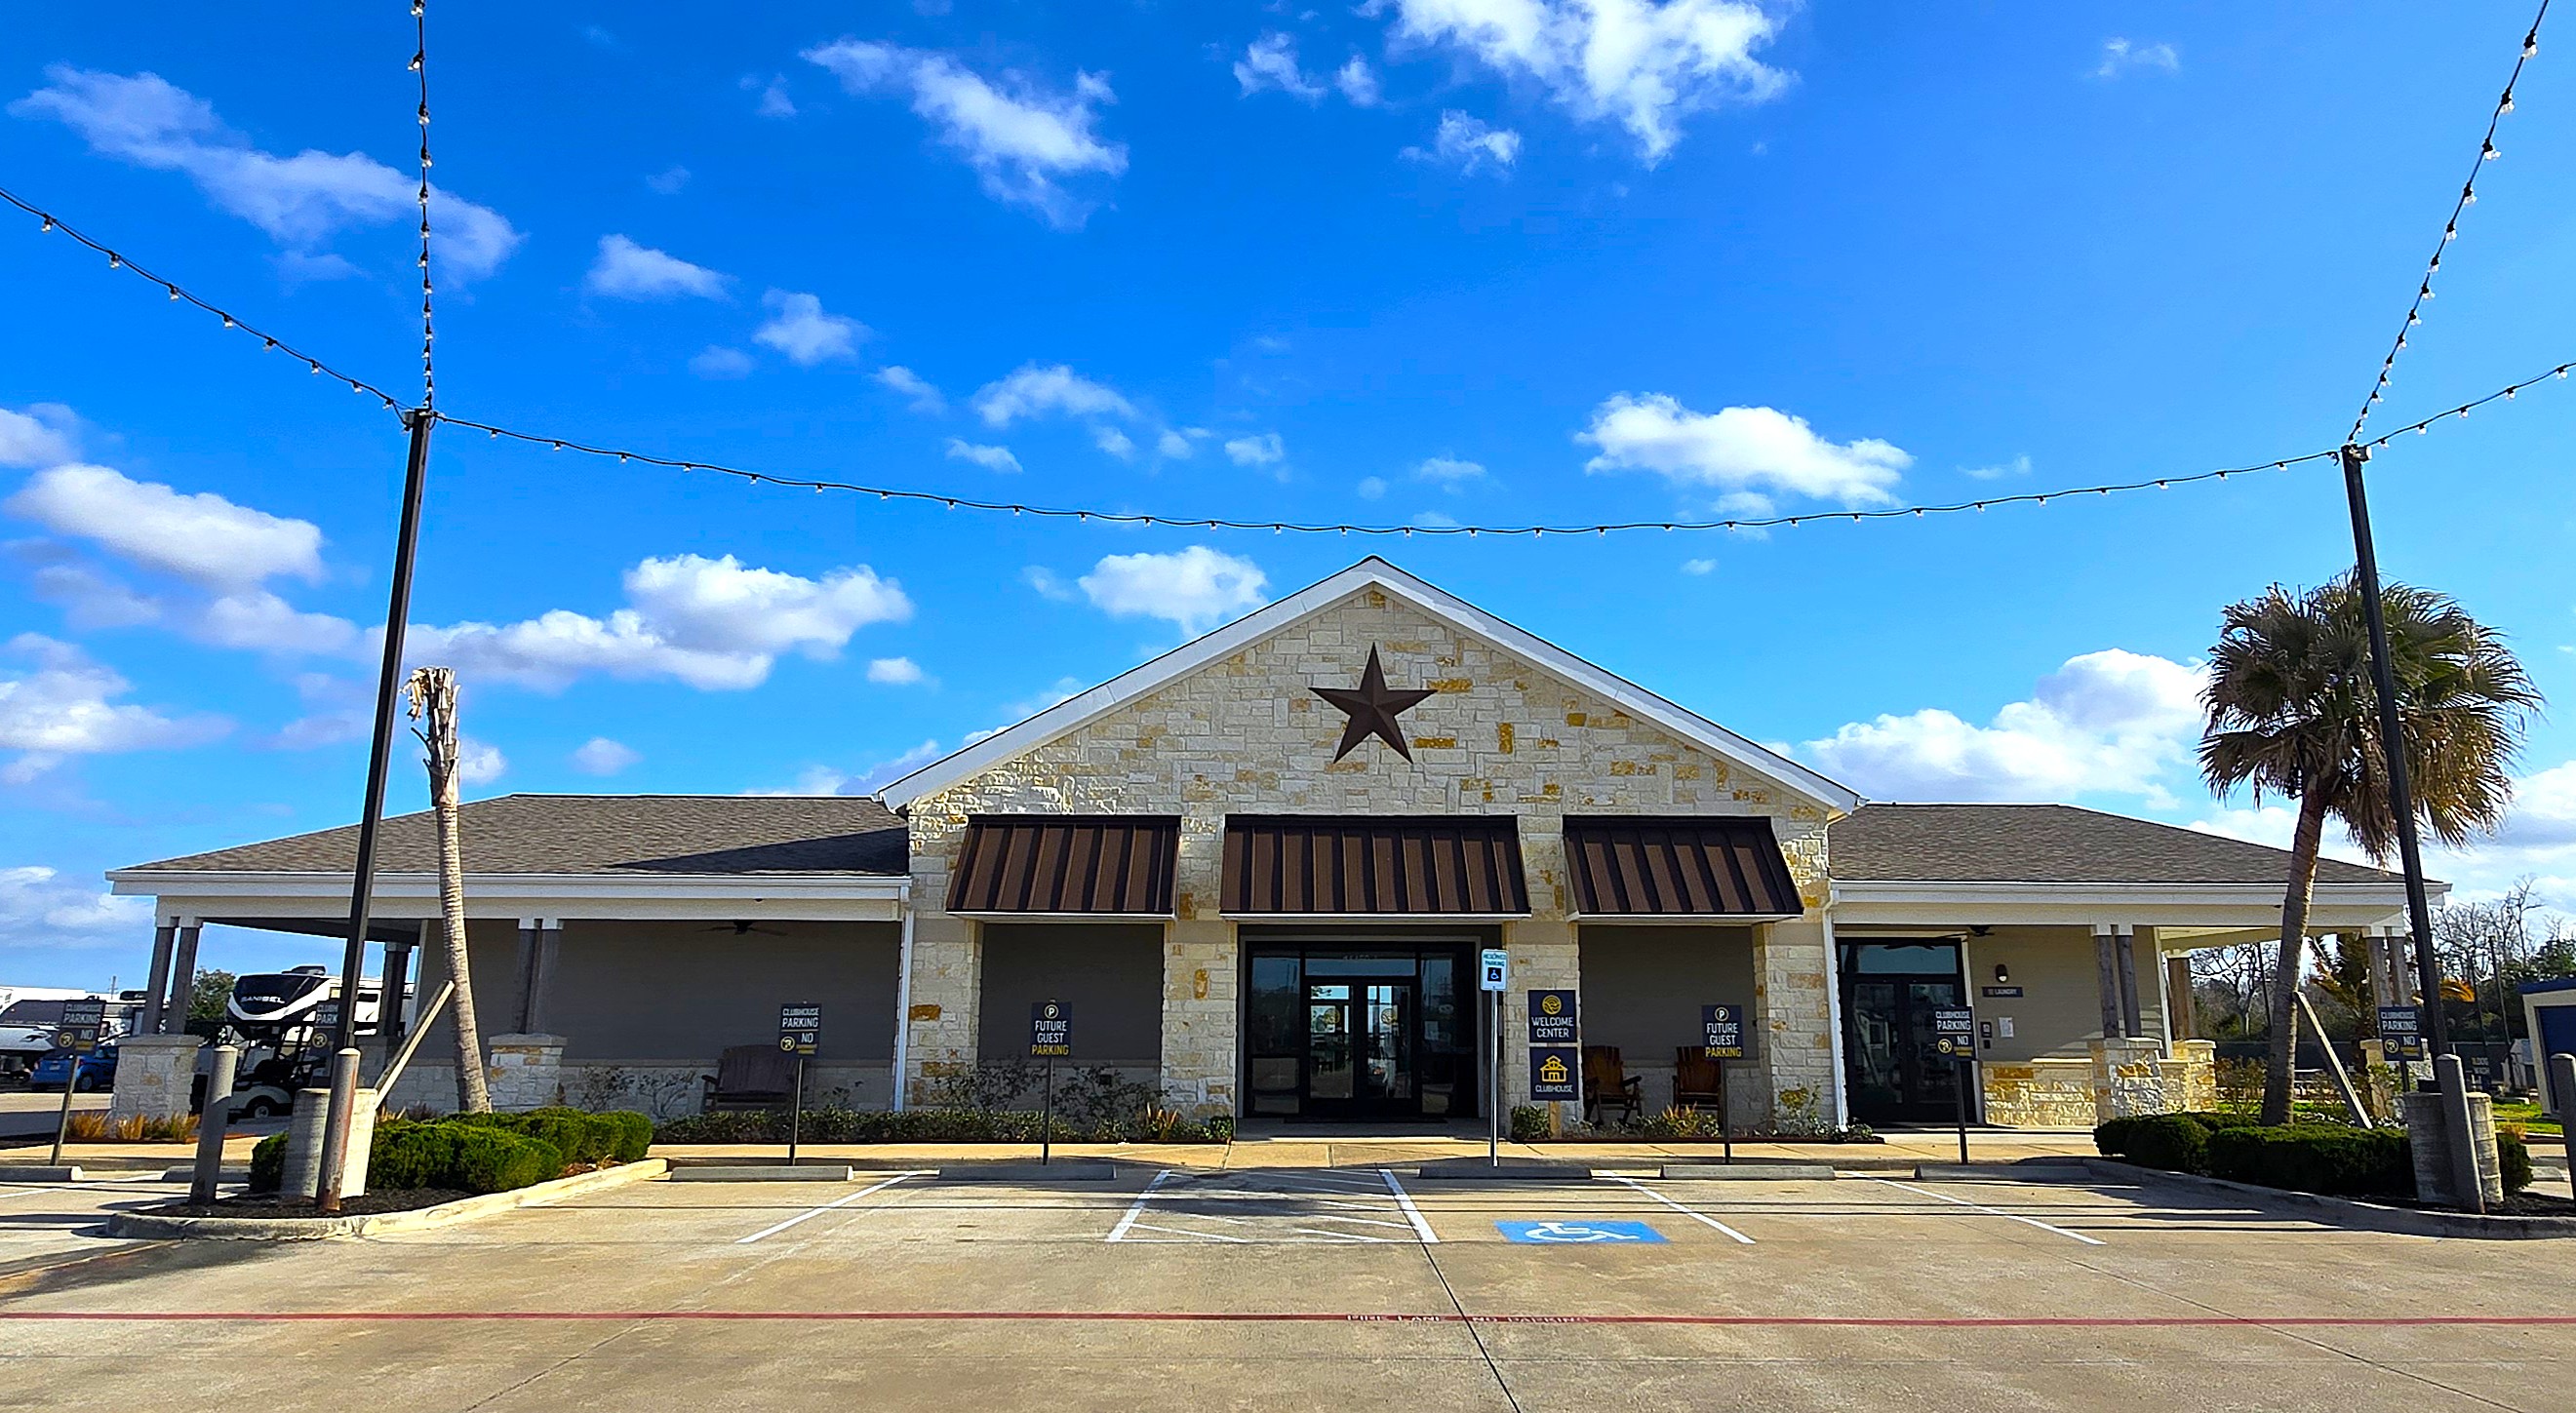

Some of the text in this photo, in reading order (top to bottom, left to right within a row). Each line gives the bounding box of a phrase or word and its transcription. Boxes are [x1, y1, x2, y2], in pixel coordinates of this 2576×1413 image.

[317, 1004, 339, 1013] CLUBH
[782, 1007, 819, 1016] CLUBHOUSE
[63, 1013, 100, 1024] PARKING
[316, 1014, 338, 1024] PARK
[1935, 1010, 1970, 1019] CLUBHOUSE
[2380, 1011, 2416, 1020] CLUBHOUSE
[781, 1017, 819, 1028] PARKING
[1035, 1020, 1068, 1032] FUTURE
[1531, 1017, 1574, 1027] WELCOME
[1936, 1020, 1971, 1031] PARKING
[2382, 1020, 2418, 1031] PARKING
[1706, 1022, 1739, 1034] FUTURE
[80, 1029, 95, 1040] NO
[801, 1033, 814, 1043] NO
[1037, 1033, 1065, 1043] GUEST
[1536, 1028, 1569, 1039] CENTER
[1709, 1035, 1736, 1045] GUEST
[1957, 1035, 1969, 1045] NO
[2403, 1036, 2416, 1046] NO
[1031, 1044, 1070, 1055] PARKING
[1705, 1046, 1742, 1058] PARKING
[1535, 1084, 1573, 1093] CLUBHOUSE
